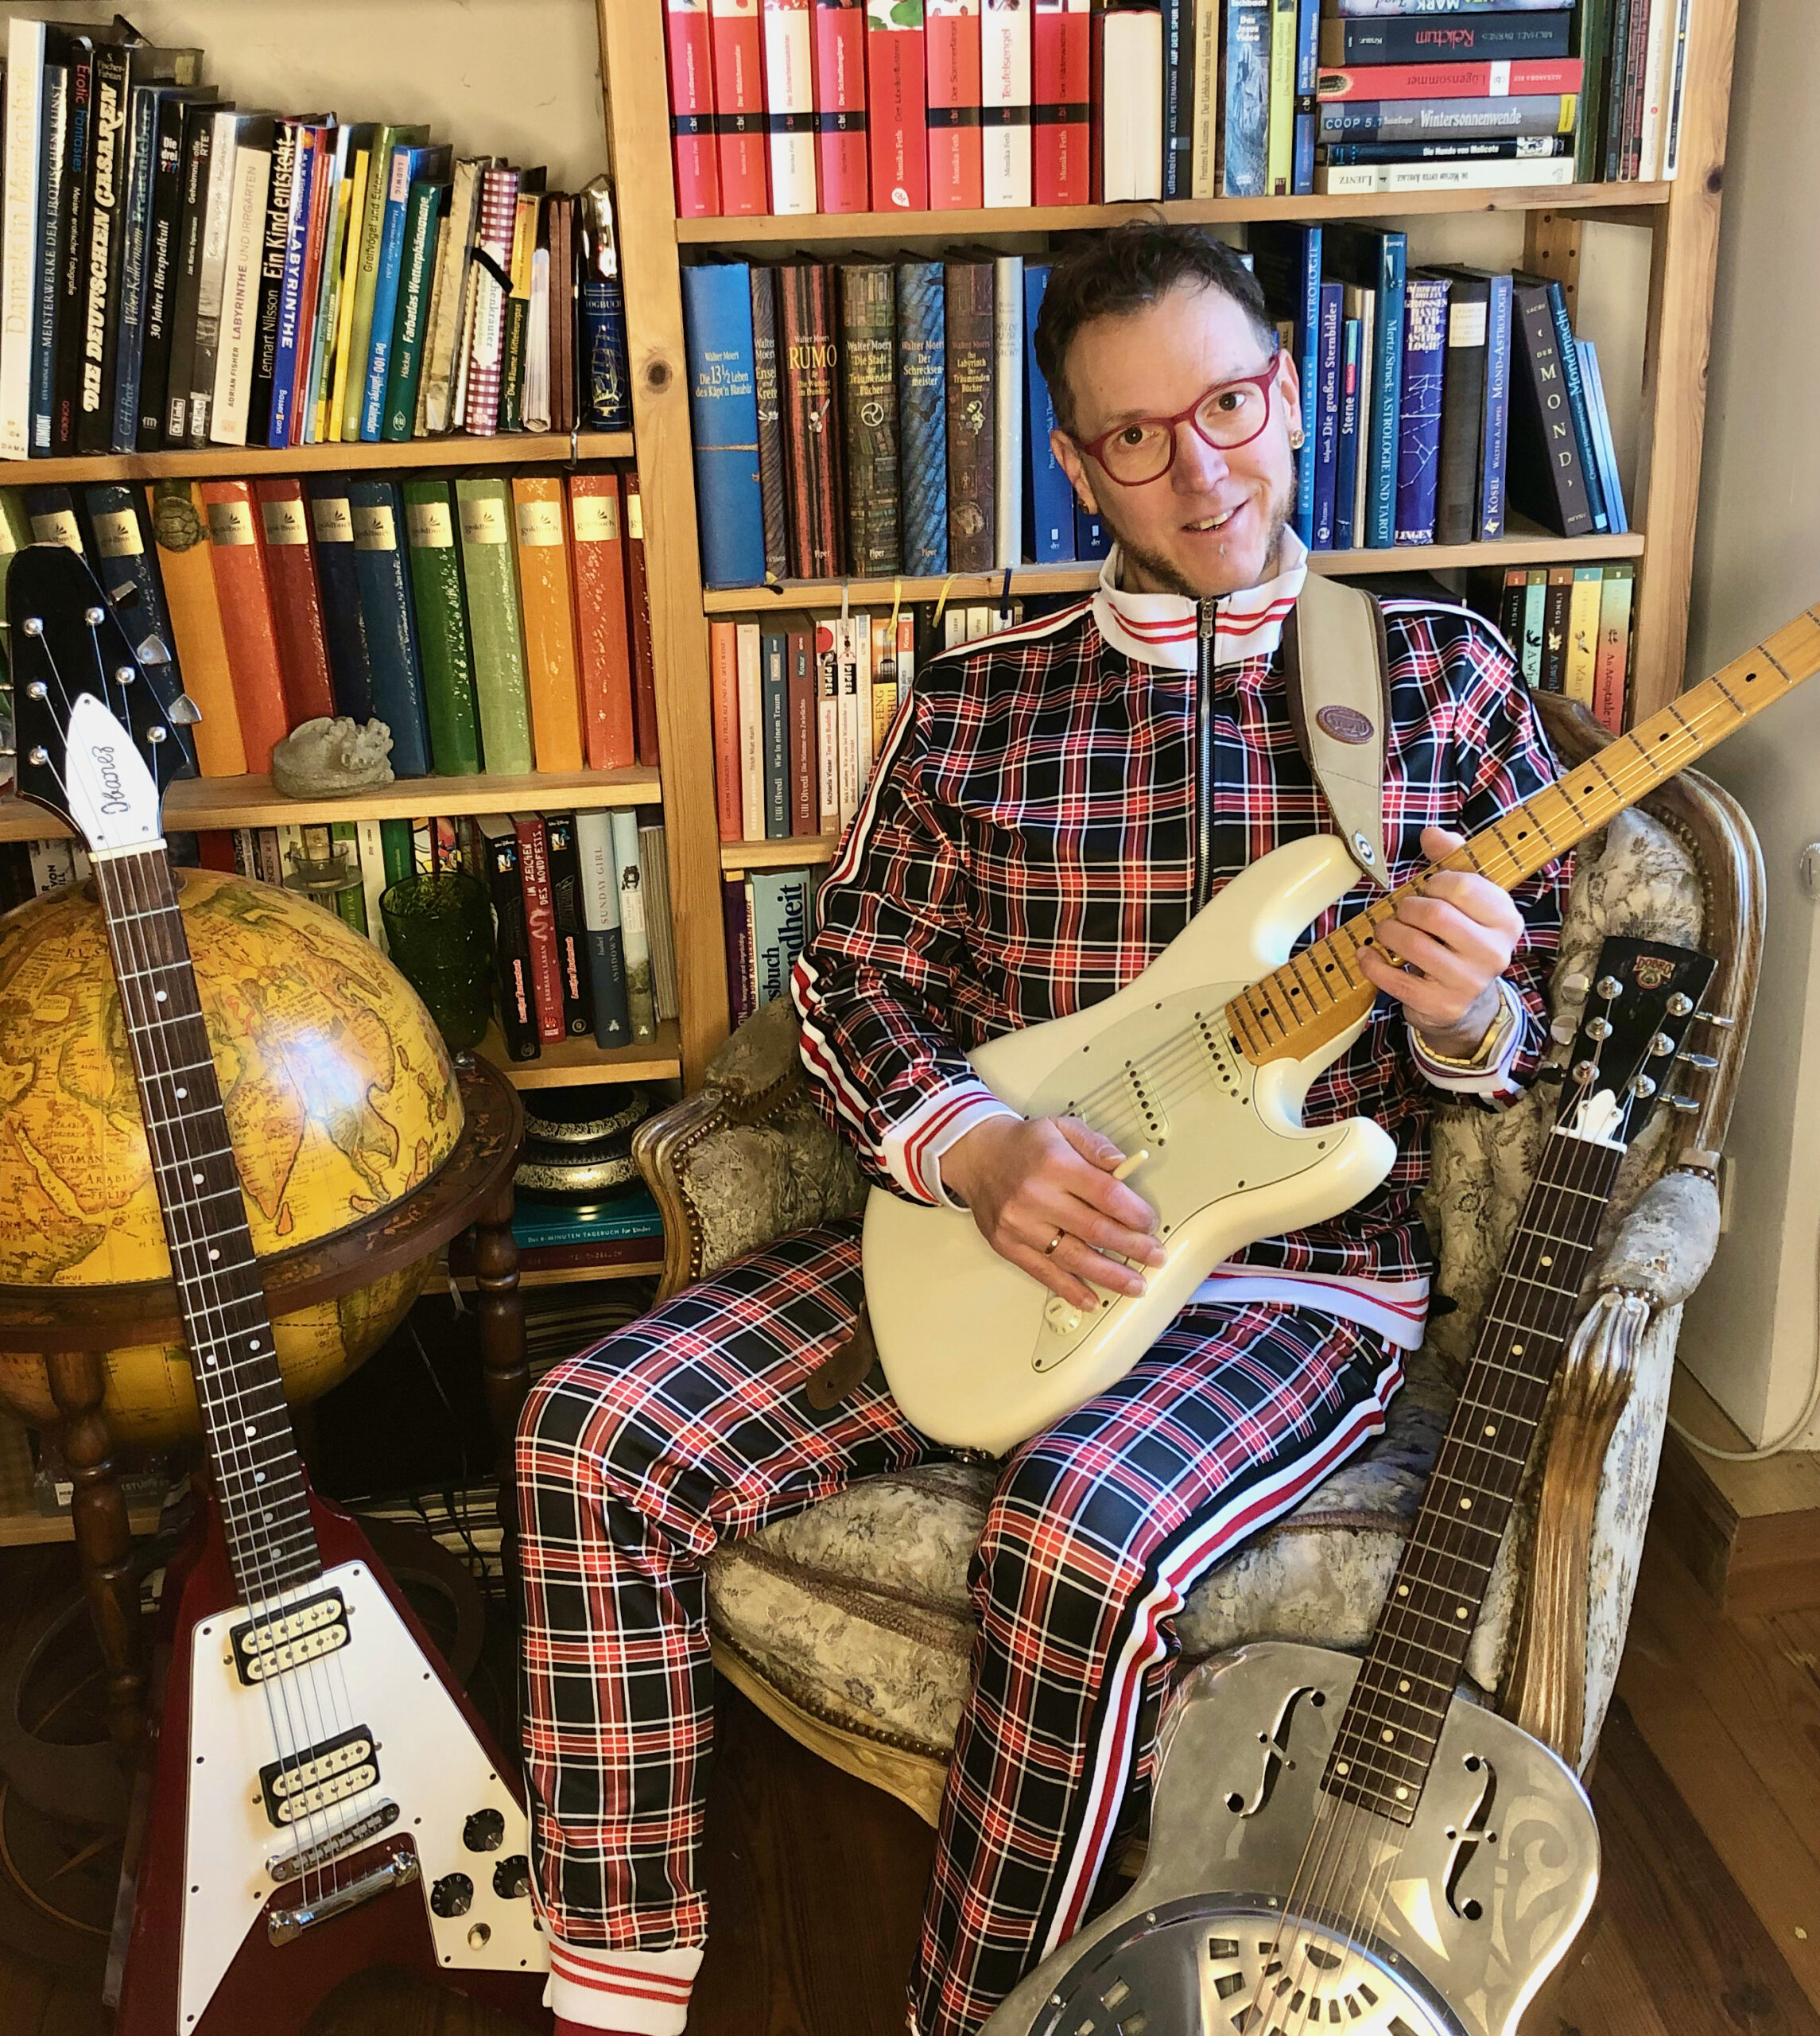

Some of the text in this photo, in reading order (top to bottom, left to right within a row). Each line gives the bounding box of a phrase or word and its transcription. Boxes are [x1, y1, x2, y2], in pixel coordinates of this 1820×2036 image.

[1415, 29, 1474, 49] Relictum
[1002, 29, 1012, 99] Teufelsengel
[72, 64, 91, 173] Erotic Fantasies
[1302, 97, 1310, 111] cbt
[1420, 108, 1521, 127] Wintersonnenwende
[1325, 117, 1382, 130] COOP 5.1
[161, 150, 179, 161] drei
[163, 136, 177, 149] Die
[394, 161, 404, 195] LUDWIG
[895, 150, 904, 181] Monika
[1168, 152, 1177, 194] ullstein
[6, 67, 30, 335] Damals in Marienbad
[42, 83, 63, 348] MEISTERWERKE DER EROTISCHEN KUNST
[263, 138, 295, 279] Ein Kind entsteht
[363, 173, 383, 273] Greifvögel und Eulen
[67, 187, 81, 296] Meister erotischer Fotografie
[150, 220, 169, 339] 30 Jahre Hörspielkult
[402, 196, 429, 344] Farbatlas Wetterphänomene
[227, 165, 255, 407] ADRIAN FISHER LABYRINTHE UND IRRGARTEN
[281, 222, 305, 349] LABYRINTHE
[1306, 246, 1318, 329] ASTROLOGIE
[258, 289, 278, 379] Lennart Nilsson
[754, 338, 774, 348] Walter
[847, 340, 891, 351] Walter Moers
[902, 340, 944, 351] Walter Moers
[1492, 286, 1507, 398] MOND-ASTROLOGIE
[507, 304, 523, 396] Die Bäume Mitteleuropas
[705, 352, 739, 362] Walter Moers
[789, 344, 837, 369] RUMO
[854, 354, 886, 365] Die Stadt
[918, 355, 930, 364] Der
[957, 359, 986, 368] Labyrinth
[1536, 348, 1552, 358] DER
[1556, 309, 1581, 396] Mondmacht
[400, 352, 411, 379] Häckel
[755, 367, 776, 379] Ensel
[903, 365, 944, 375] Schrecksen-
[860, 384, 883, 394] Bücher
[912, 377, 938, 387] meister
[962, 384, 983, 393] Bücher
[1322, 301, 1338, 463] Ridpath Die großen Sternbilder
[1341, 397, 1355, 434] Sterne
[1540, 363, 1572, 467] MOND
[36, 414, 52, 447] DUMONT
[1492, 438, 1502, 468] WALTER
[1487, 477, 1500, 514] KÖSEL
[465, 523, 503, 534] goldbuch
[577, 520, 615, 530] goldbuch
[1320, 502, 1329, 526] Patmos
[521, 525, 559, 536] goldbuch
[815, 550, 830, 559] Piper
[870, 549, 884, 559] Piper
[825, 666, 833, 694] PIPER
[1576, 664, 1585, 693] Many
[1603, 654, 1615, 716] An Acceptable
[875, 690, 885, 720] FENG
[91, 746, 130, 815] Ibanez
[774, 778, 782, 804] Olvedi
[799, 775, 809, 818] Ulli Olvedi
[47, 865, 58, 888] VON
[522, 843, 537, 896] IM ZEICHEN
[533, 831, 549, 905] DES MONDFESTS
[594, 846, 609, 924] SUNDAY GIRL
[596, 936, 605, 956] Isabel
[609, 934, 619, 982] ASHDOWN
[540, 945, 551, 1001] BARBARA LABAN
[1636, 956, 1673, 975] DOBRO
[87, 1173, 135, 1184] ARABIA
[91, 1191, 129, 1200] FELIX
